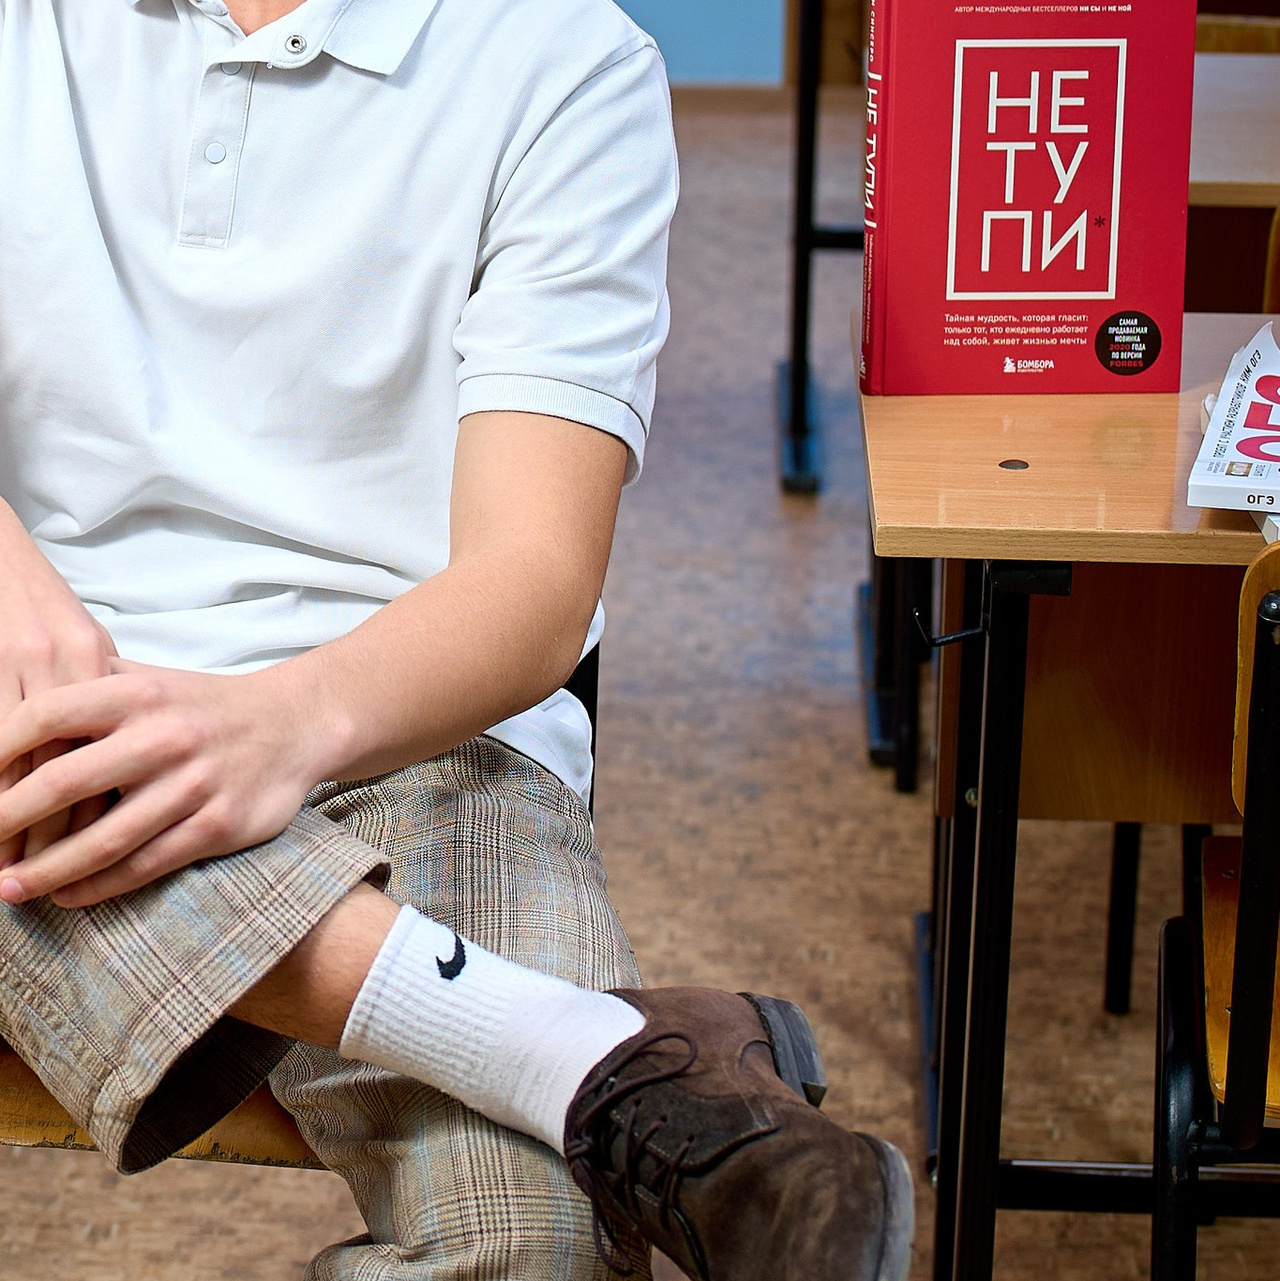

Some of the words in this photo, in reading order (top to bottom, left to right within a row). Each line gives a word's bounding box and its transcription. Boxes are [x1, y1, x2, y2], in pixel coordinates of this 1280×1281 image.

[987, 70, 1090, 134] НЕ
[986, 141, 1090, 205] ТУ
[945, 314, 975, 322] Тайная
[977, 315, 1020, 324] мудрость,
[1022, 315, 1055, 323] которая
[944, 326, 972, 334] только
[990, 326, 1004, 334] кто
[1005, 326, 1050, 334] ежедневно
[1052, 325, 1088, 335] работает
[943, 338, 960, 346] над
[962, 337, 990, 346] собой,
[1017, 359, 1054, 369] БОМБОРА
[1239, 365, 1253, 384] КИМ
[1250, 349, 1262, 368] ОГЭ
[1247, 494, 1275, 505] ОГЭ
